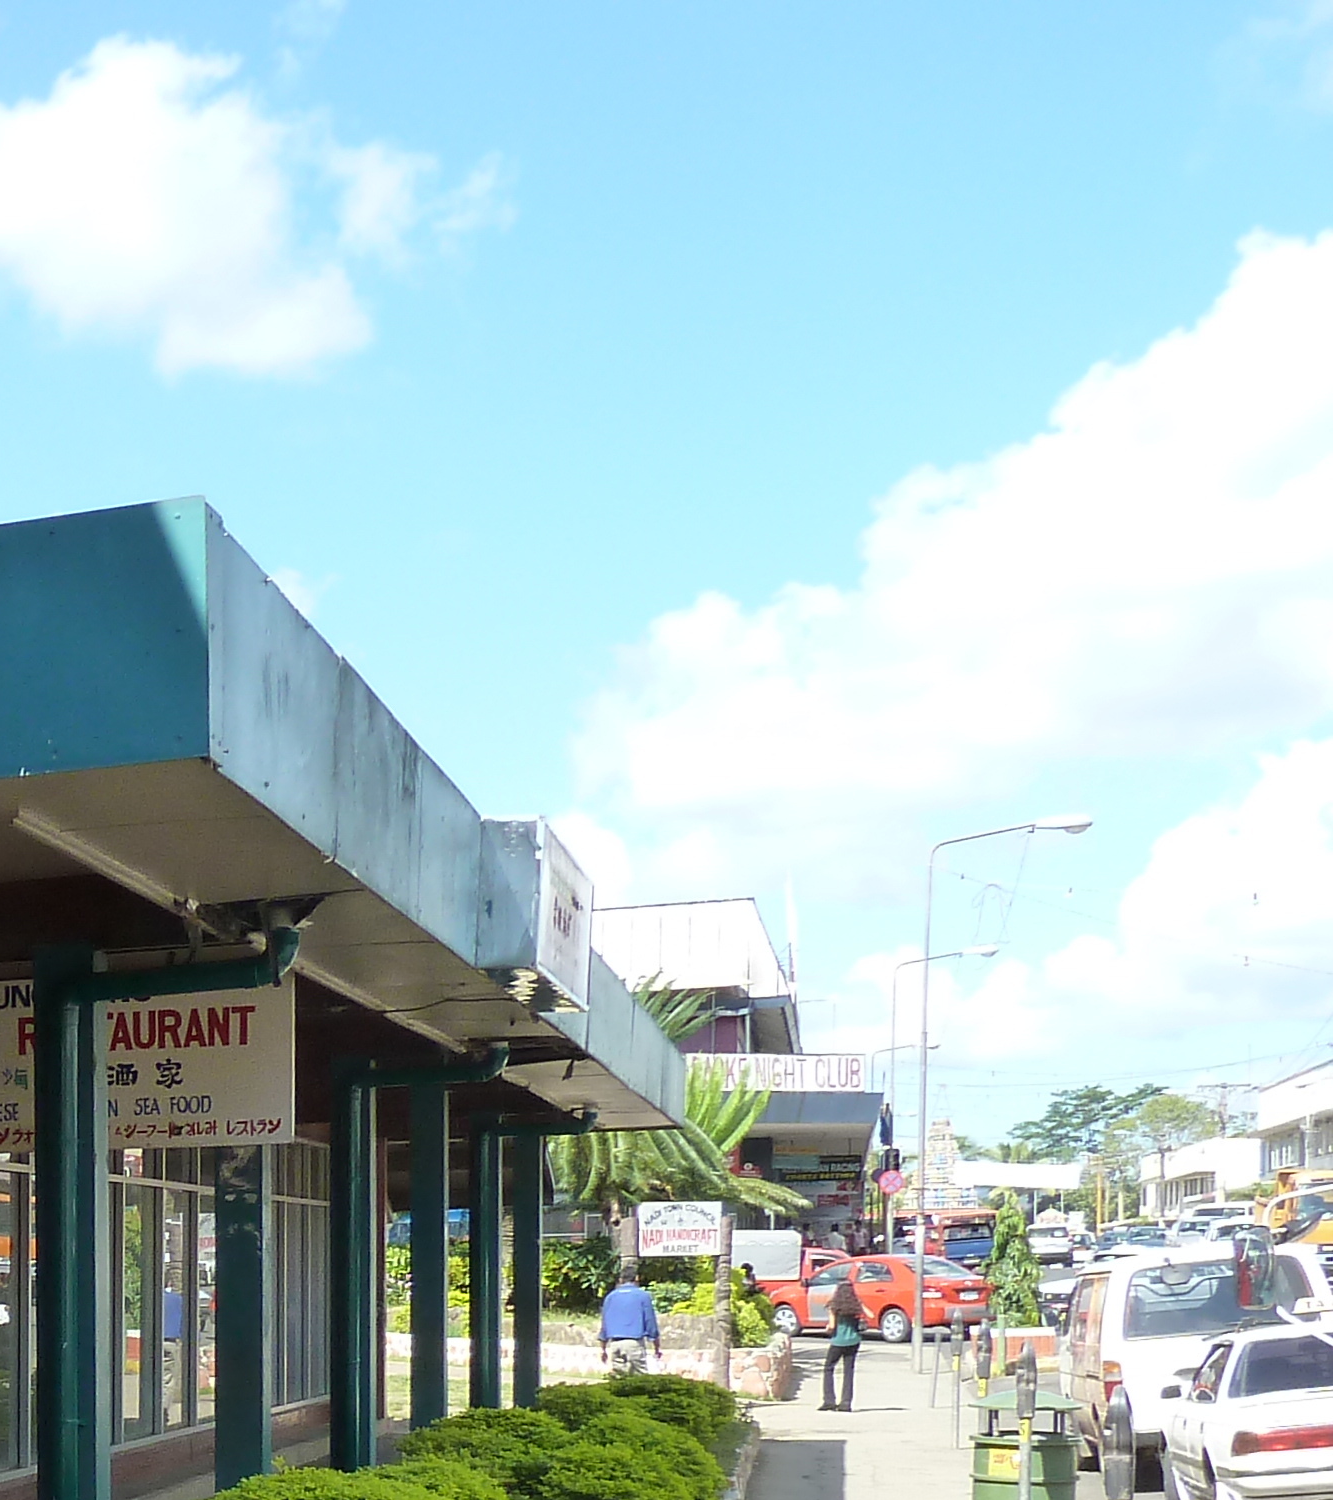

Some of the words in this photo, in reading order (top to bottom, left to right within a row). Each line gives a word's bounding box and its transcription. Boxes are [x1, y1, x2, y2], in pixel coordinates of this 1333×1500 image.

[754, 1056, 807, 1089] NIGHT
[815, 1057, 861, 1089] CLUB
[134, 1098, 161, 1116] SEA
[170, 1095, 212, 1114] FOOD
[642, 1229, 664, 1251] NADI
[666, 1228, 718, 1249] HANDICRAFT
[662, 1244, 699, 1253] MARKET
